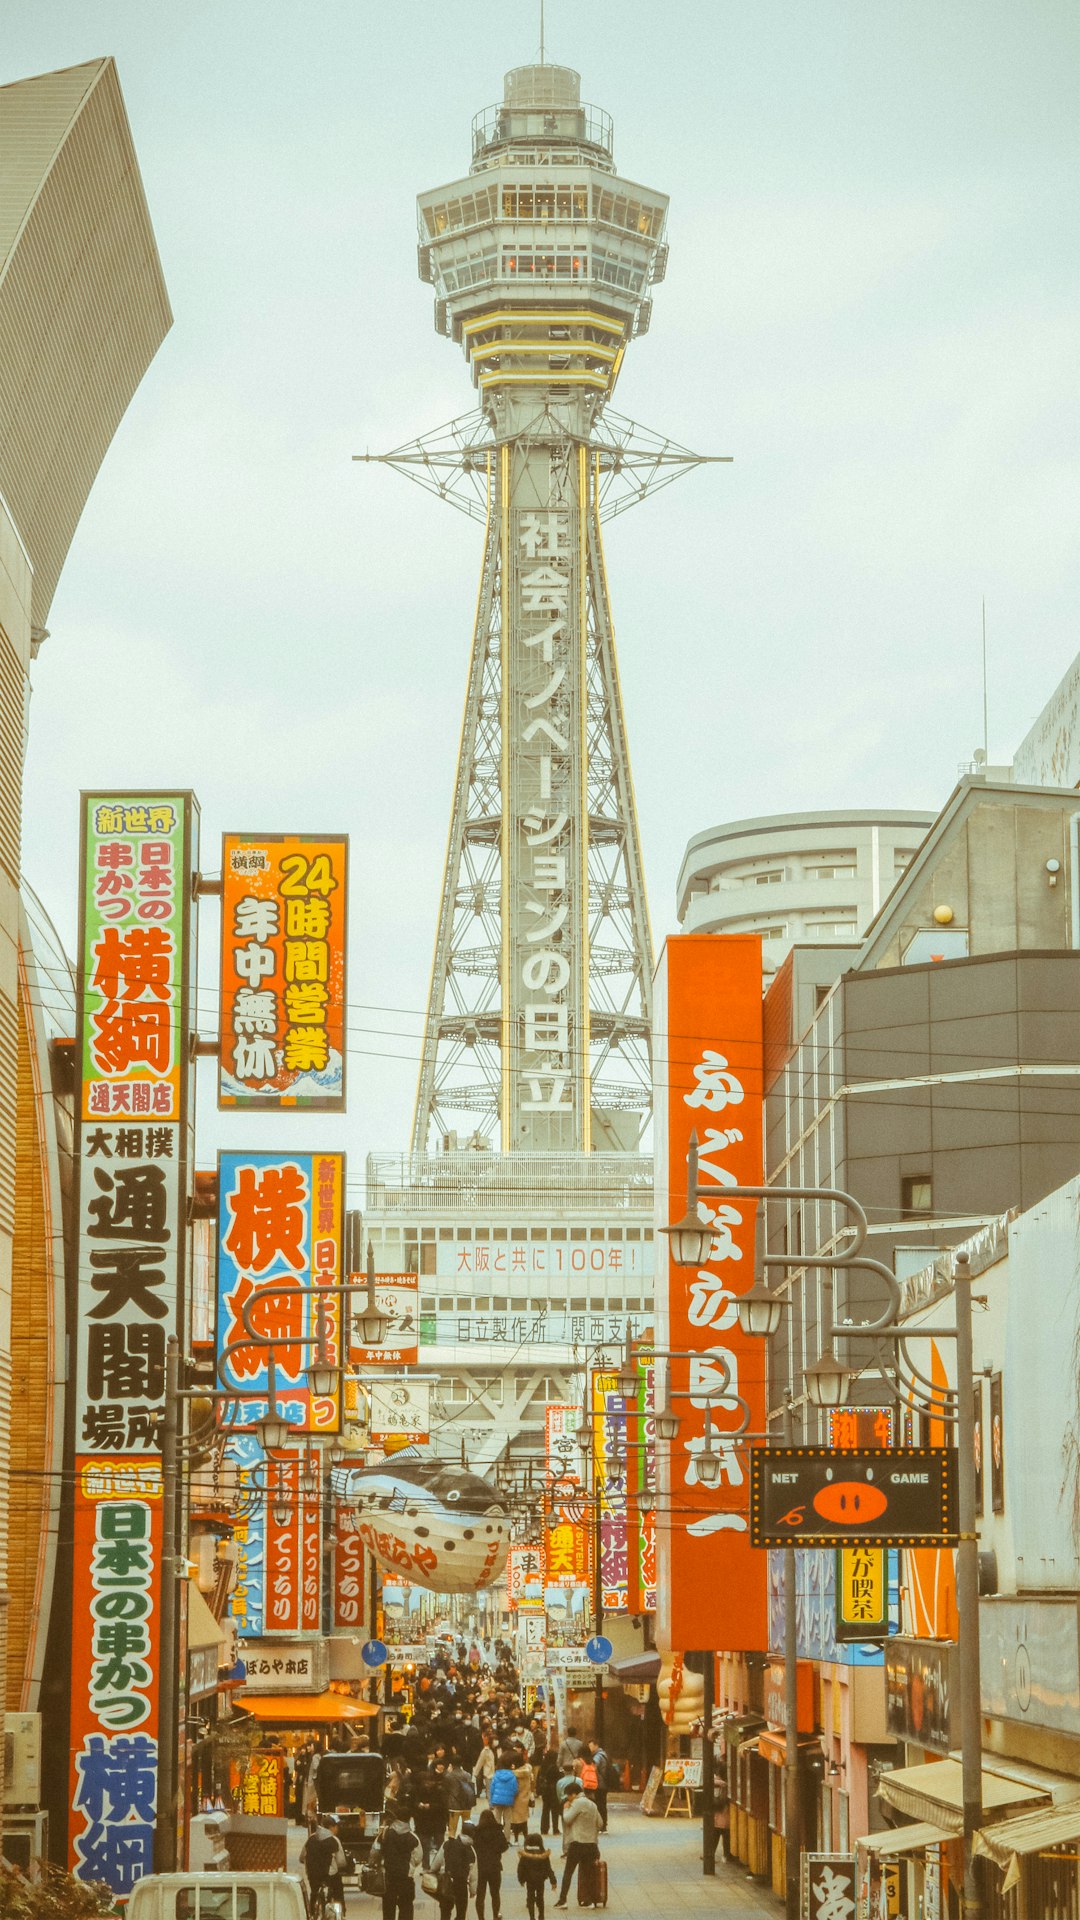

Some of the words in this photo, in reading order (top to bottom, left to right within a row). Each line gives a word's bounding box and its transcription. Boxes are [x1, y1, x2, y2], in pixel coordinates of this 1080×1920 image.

[96, 806, 176, 834] 新世界
[520, 513, 570, 1111] 社会イノベーションの日立
[97, 843, 133, 920] 串かつ
[137, 842, 172, 920] 日本一の
[231, 856, 265, 869] 横綱
[233, 898, 278, 1078] 年中無休
[279, 856, 337, 1071] 24時間営業
[93, 927, 173, 1074] 横綱
[90, 1084, 171, 1113] 通天閣店
[86, 1127, 174, 1158] 大相撲
[318, 1158, 335, 1233] 新世界
[84, 1165, 171, 1401] 通天閣
[226, 1166, 306, 1378] 横綱
[314, 1241, 336, 1424] 日本一の串つ
[366, 1351, 401, 1360] 年中無休
[458, 1317, 545, 1342] 日立製作所
[82, 1405, 167, 1450] 場所
[604, 1395, 627, 1509] 日本一のかつ
[86, 1469, 162, 1493] 新世界
[772, 1473, 798, 1483] NET
[891, 1473, 929, 1483] GAME
[520, 1553, 538, 1573] 串
[550, 1525, 574, 1575] 通天
[94, 1506, 148, 1725] 日本一の串かつ
[244, 1659, 308, 1675] ぼらや本店
[244, 1775, 260, 1816] 営業
[259, 1759, 280, 1815] 24時間
[77, 1736, 158, 1895] 横綱
